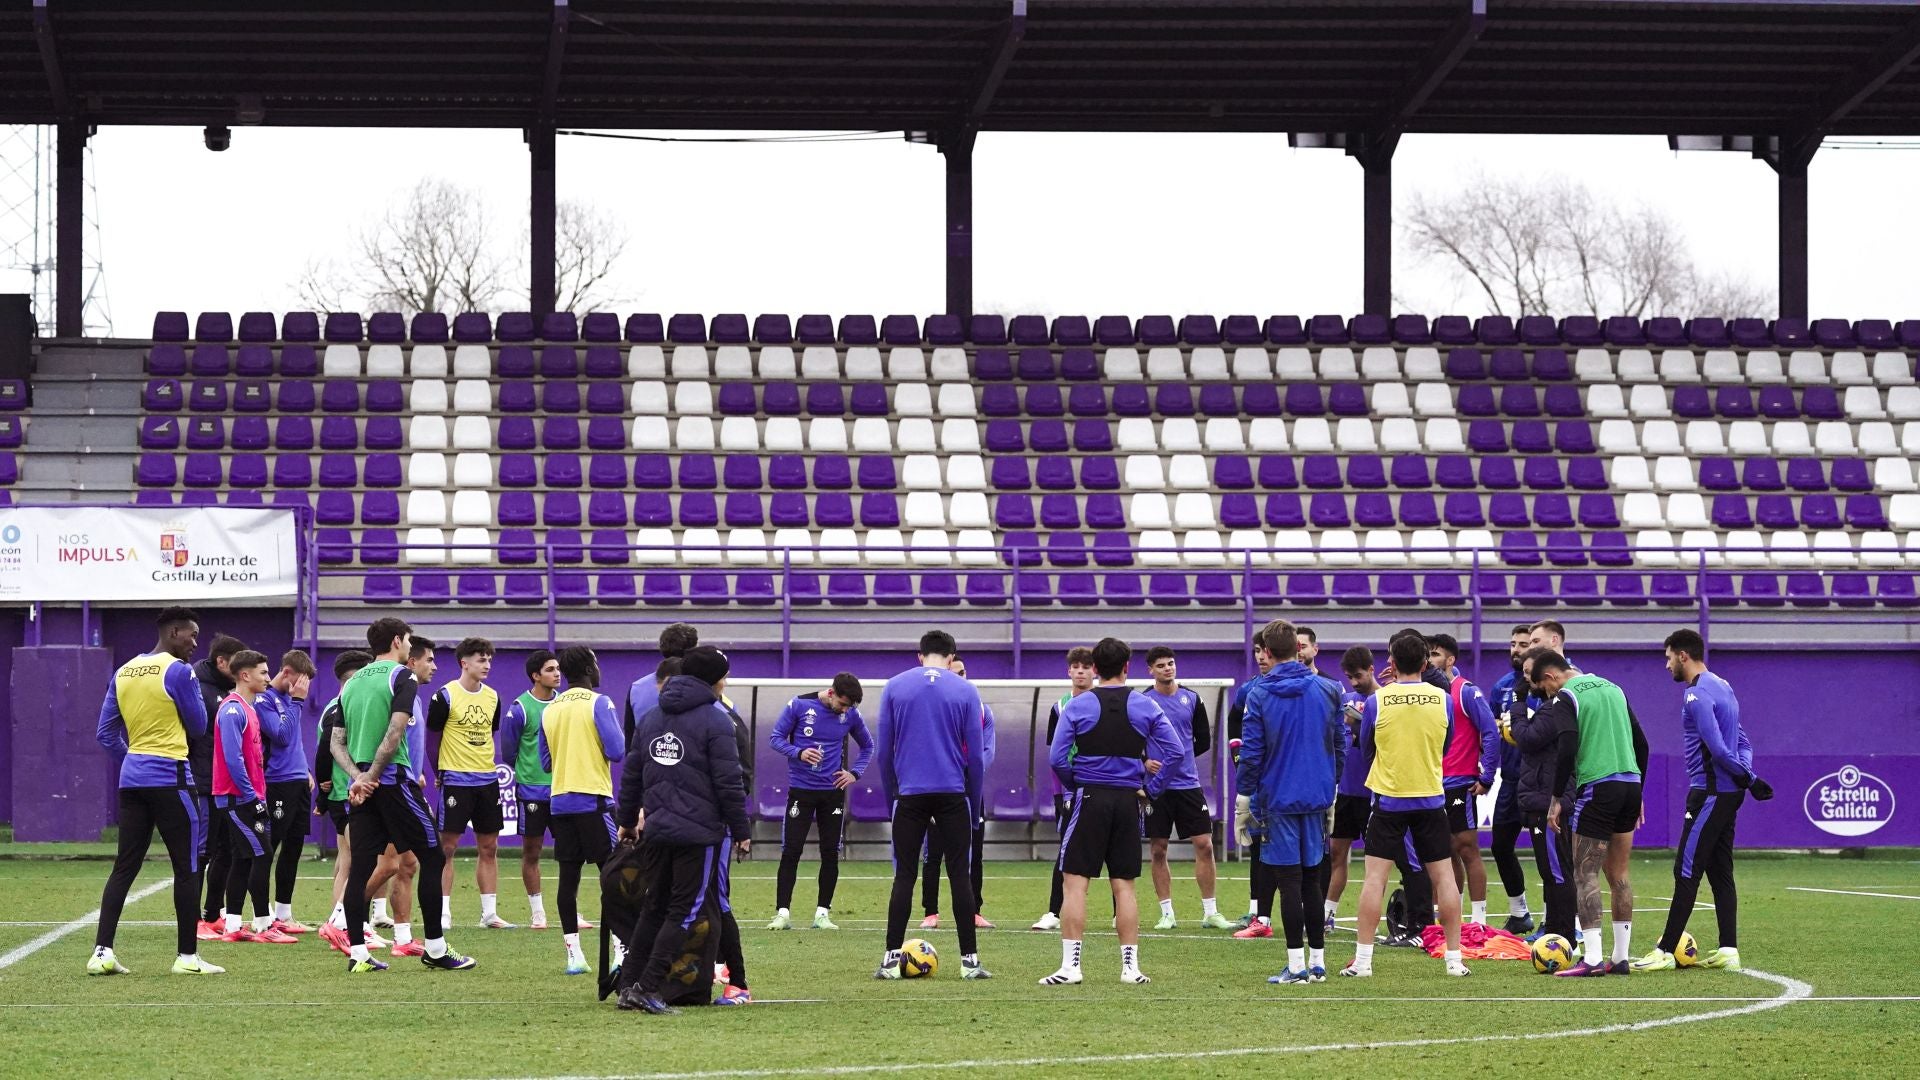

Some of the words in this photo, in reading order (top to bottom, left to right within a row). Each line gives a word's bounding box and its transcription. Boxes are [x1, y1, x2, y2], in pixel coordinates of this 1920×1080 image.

[58, 534, 89, 545] NOS
[193, 555, 235, 567] Junta
[239, 555, 258, 567] de
[151, 570, 204, 582] Castilla
[208, 572, 217, 585] y
[222, 569, 259, 582] León
[1383, 694, 1441, 707] Kappa
[1819, 785, 1880, 802] Estrella
[1821, 801, 1877, 819] Galicia
